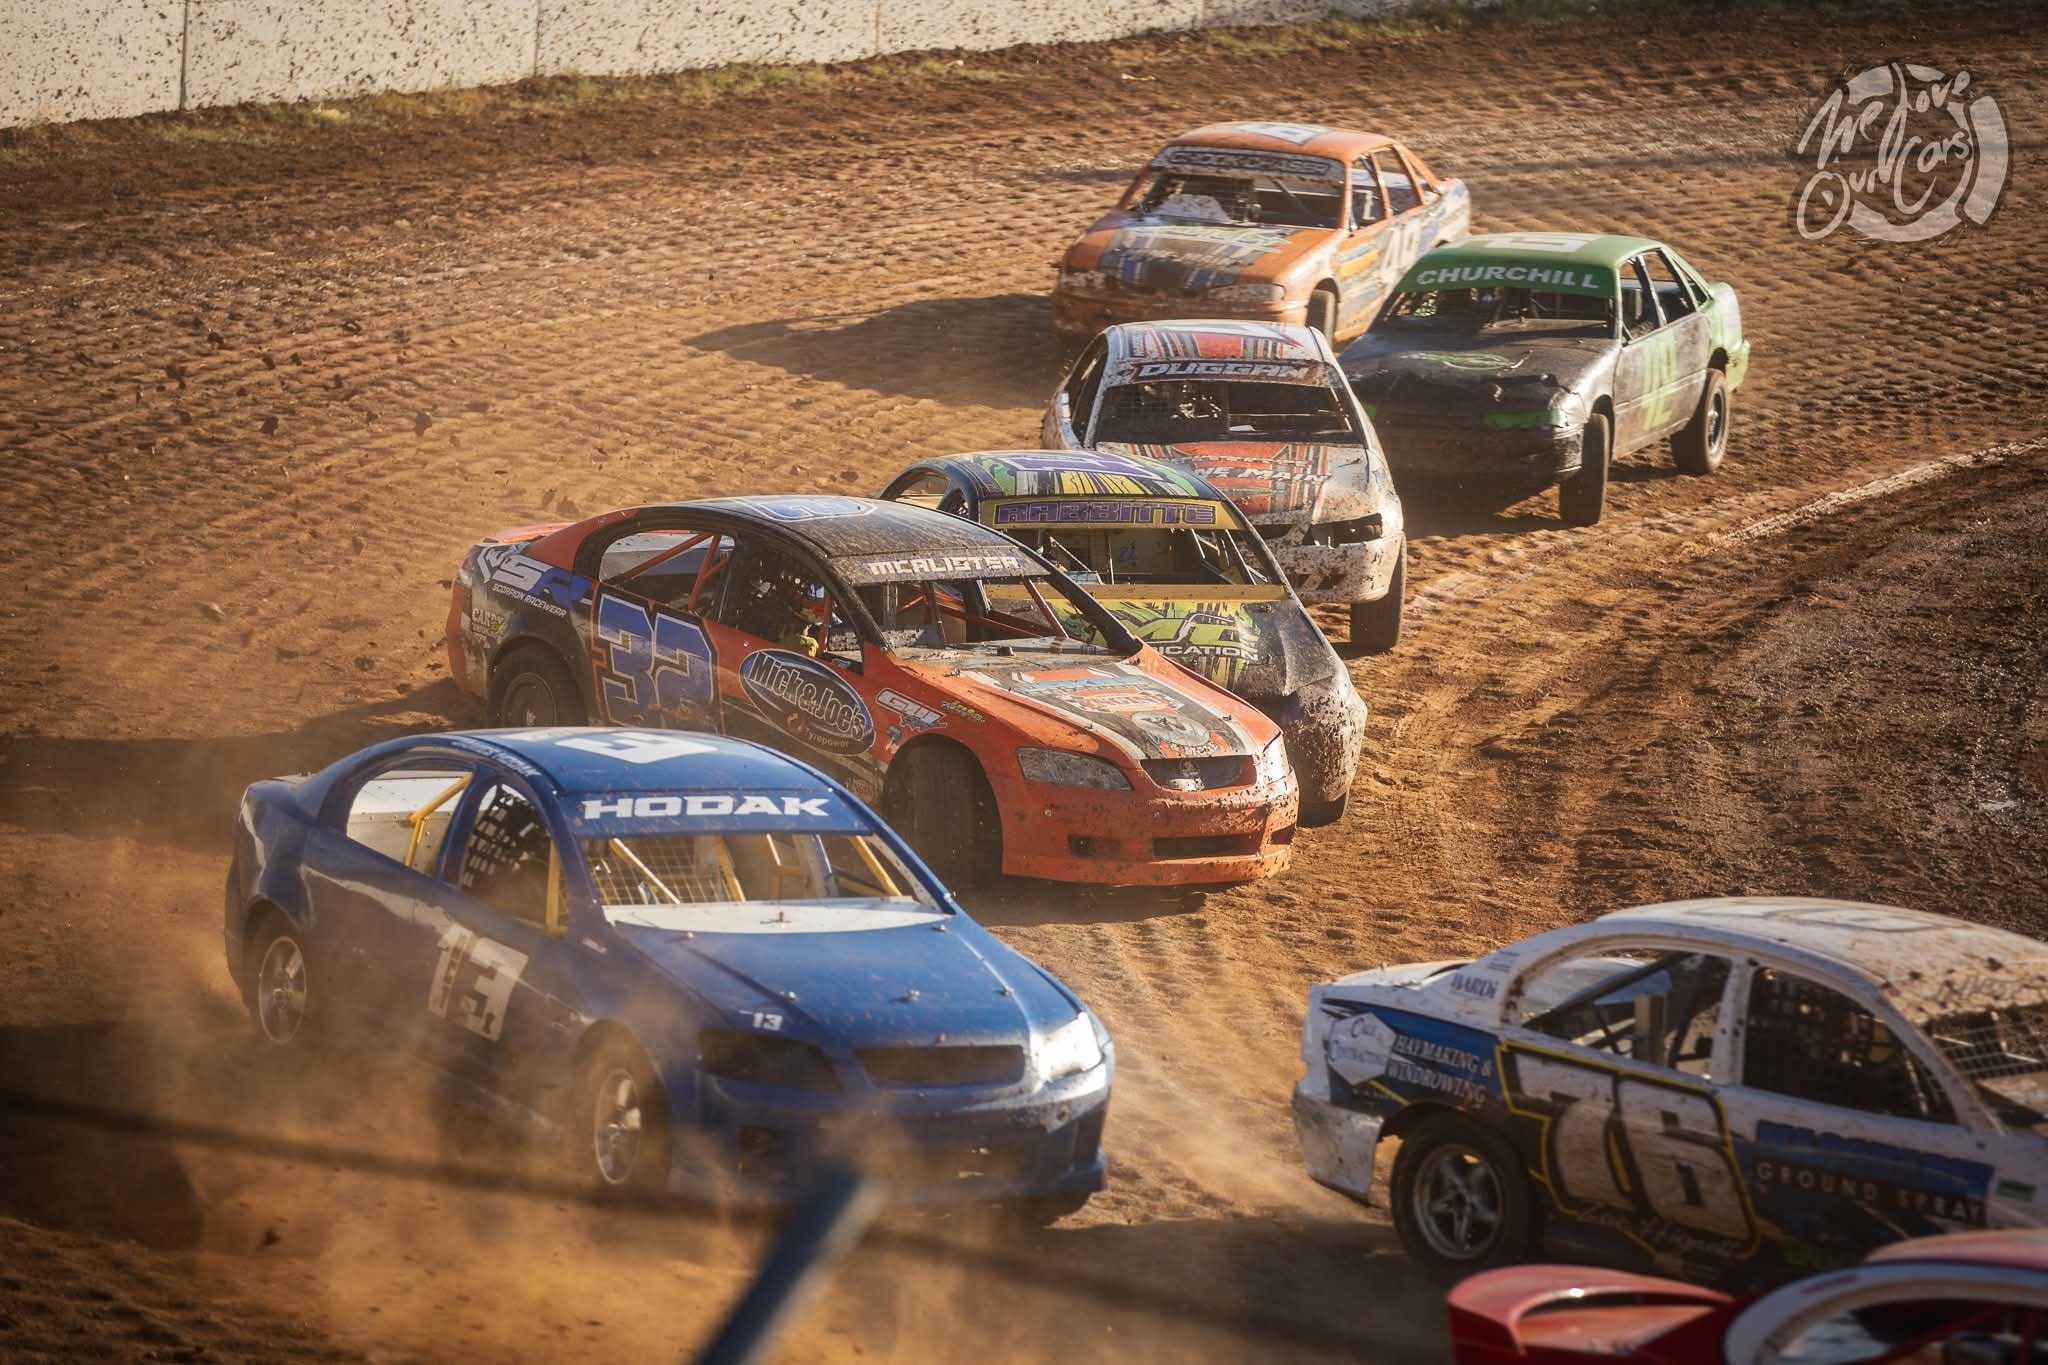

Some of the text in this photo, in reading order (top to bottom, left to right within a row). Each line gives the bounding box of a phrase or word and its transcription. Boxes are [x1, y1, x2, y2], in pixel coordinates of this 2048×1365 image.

[1416, 266, 1600, 289] CHURCHILL
[1138, 362, 1308, 379] DUGGAN
[997, 501, 1215, 524] RABBITTE
[863, 557, 1020, 575] MCALISTER
[492, 583, 567, 618] SCORPION RACEWEAR
[598, 594, 714, 727] 32
[750, 652, 804, 705] Mick
[816, 687, 867, 742] Joe's
[806, 728, 849, 748] Tyrepower
[581, 796, 830, 820] HODAK
[428, 921, 529, 1042] 13
[752, 1012, 783, 1031] 13
[1396, 1035, 1480, 1072] HAYMAKING
[1481, 1060, 1492, 1077] &
[1388, 1063, 1487, 1104] WINDROWING
[1515, 1053, 1750, 1242] 76
[1757, 1162, 1878, 1199] GROUND
